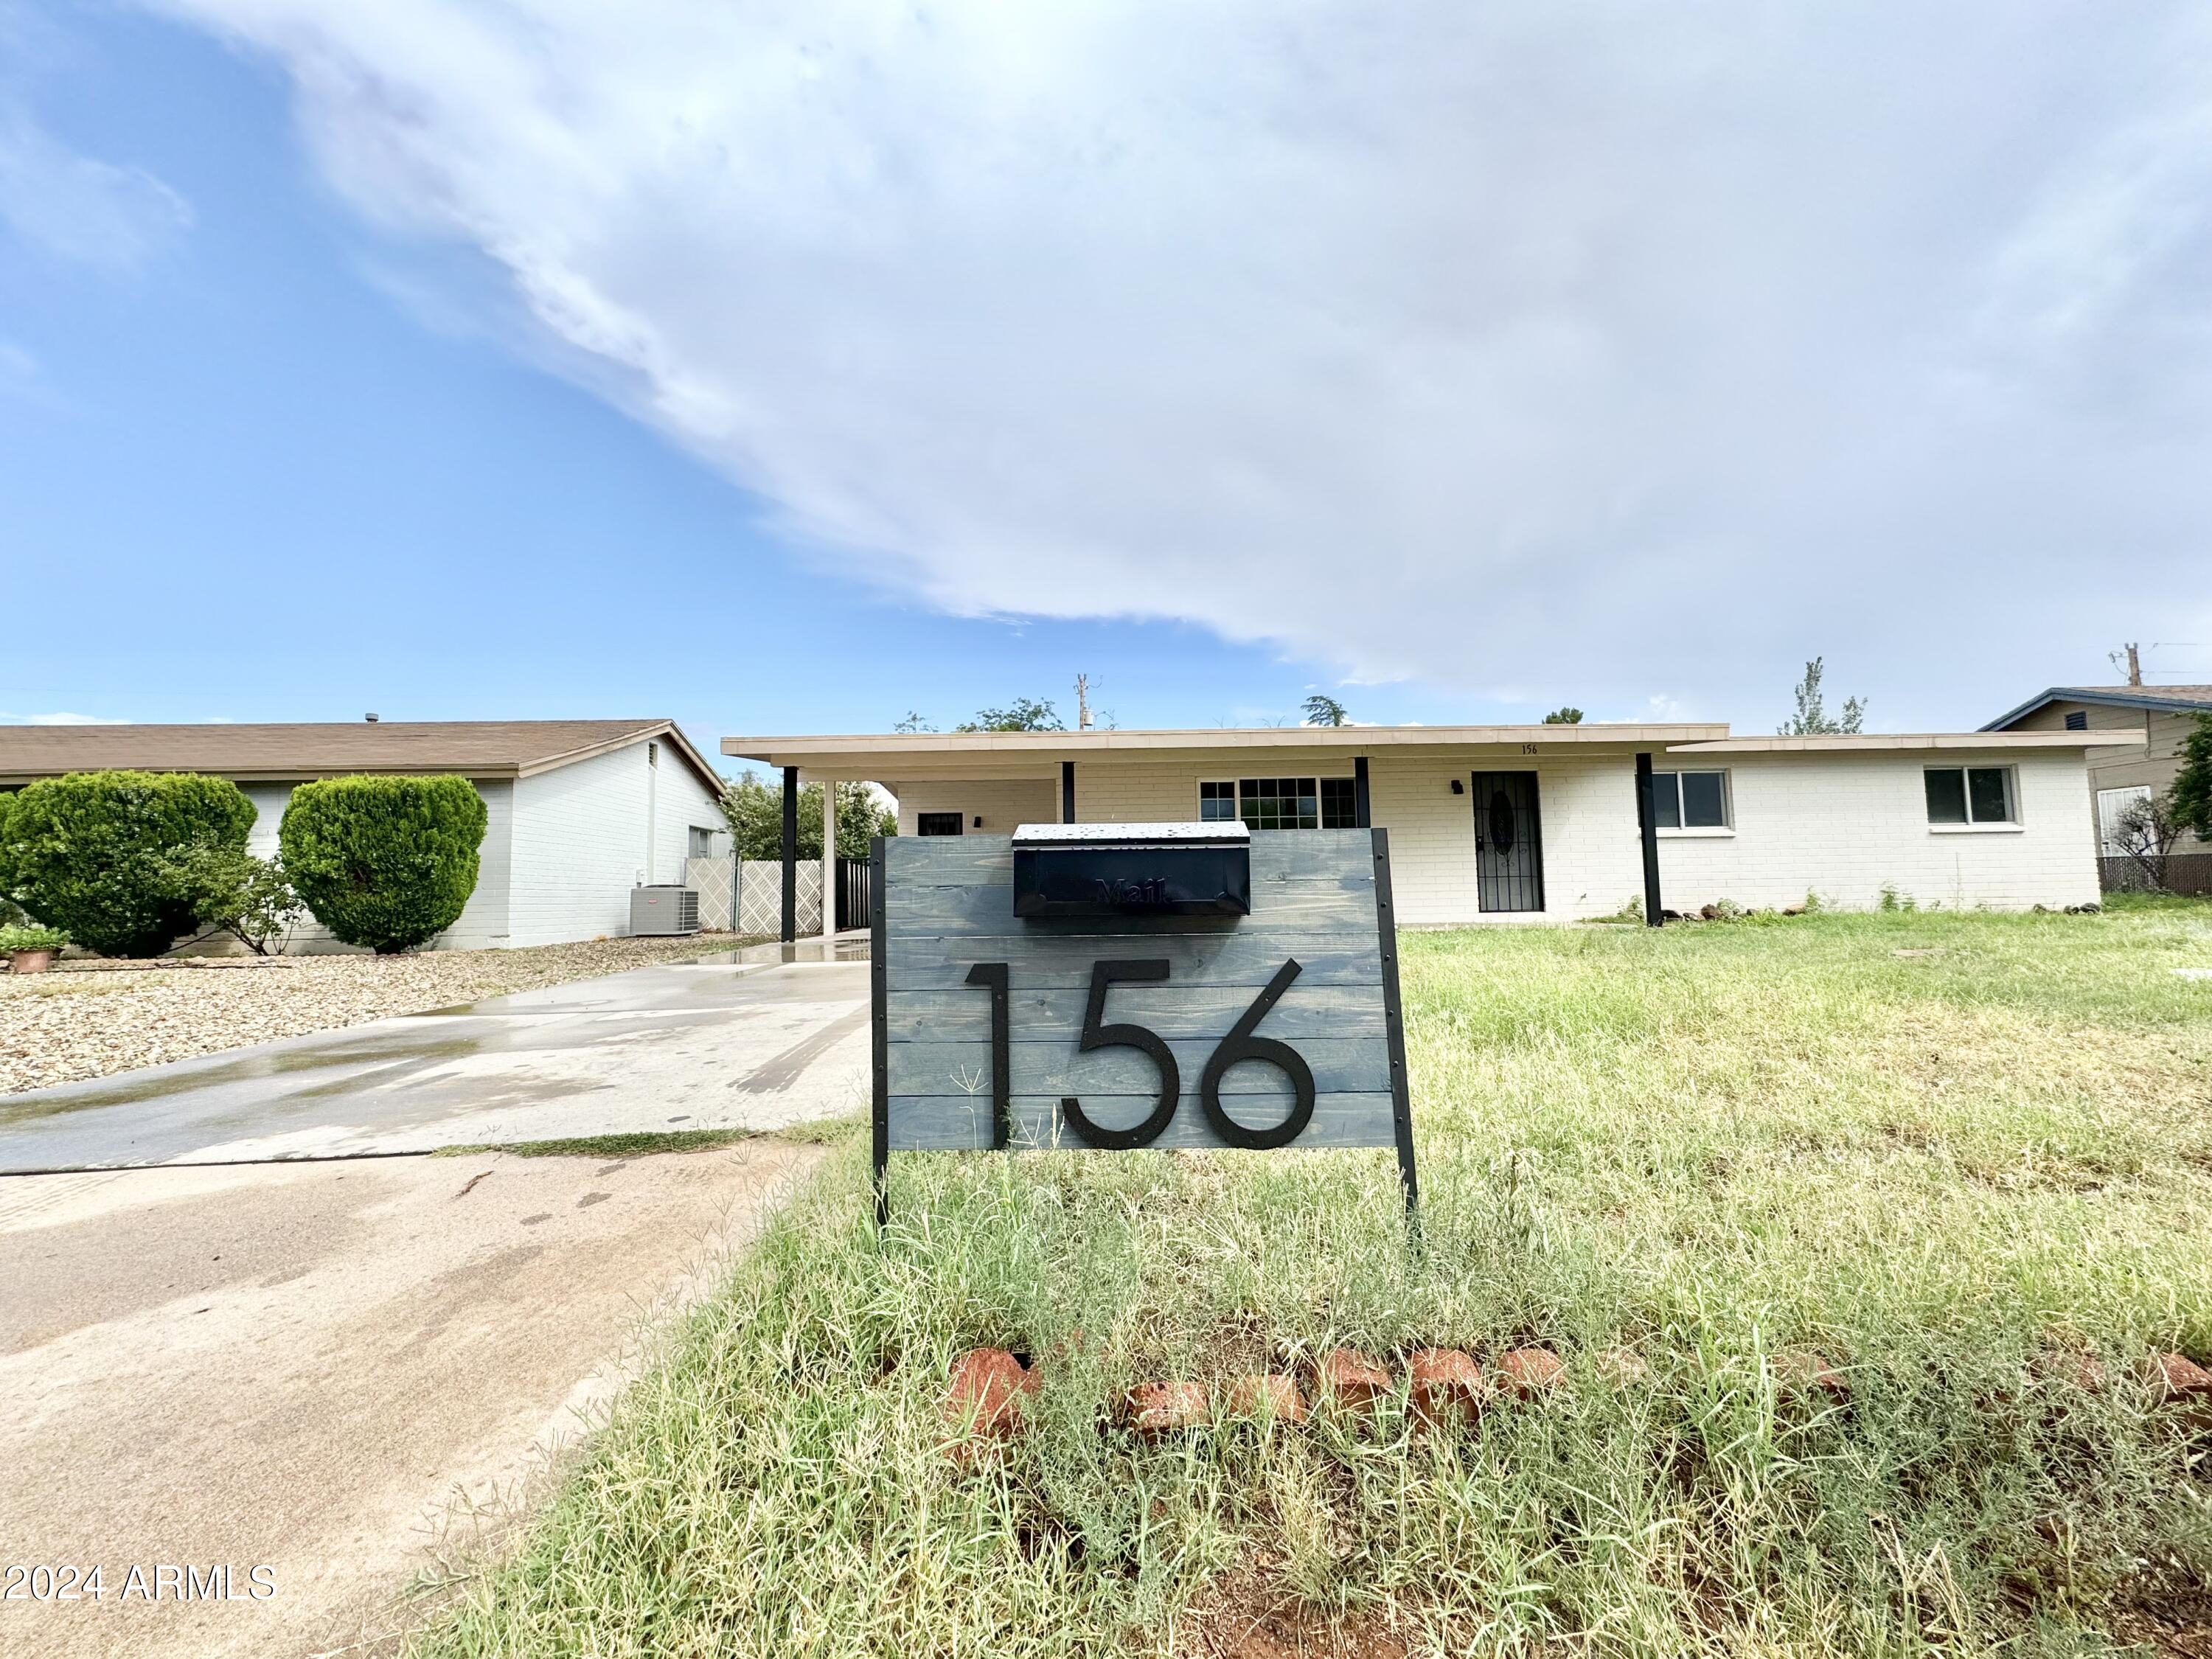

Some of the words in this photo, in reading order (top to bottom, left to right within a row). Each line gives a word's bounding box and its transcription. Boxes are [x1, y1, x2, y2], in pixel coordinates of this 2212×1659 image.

[1522, 743, 1537, 755] 156
[1094, 877, 1171, 905] Mail
[964, 957, 1315, 1150] 156
